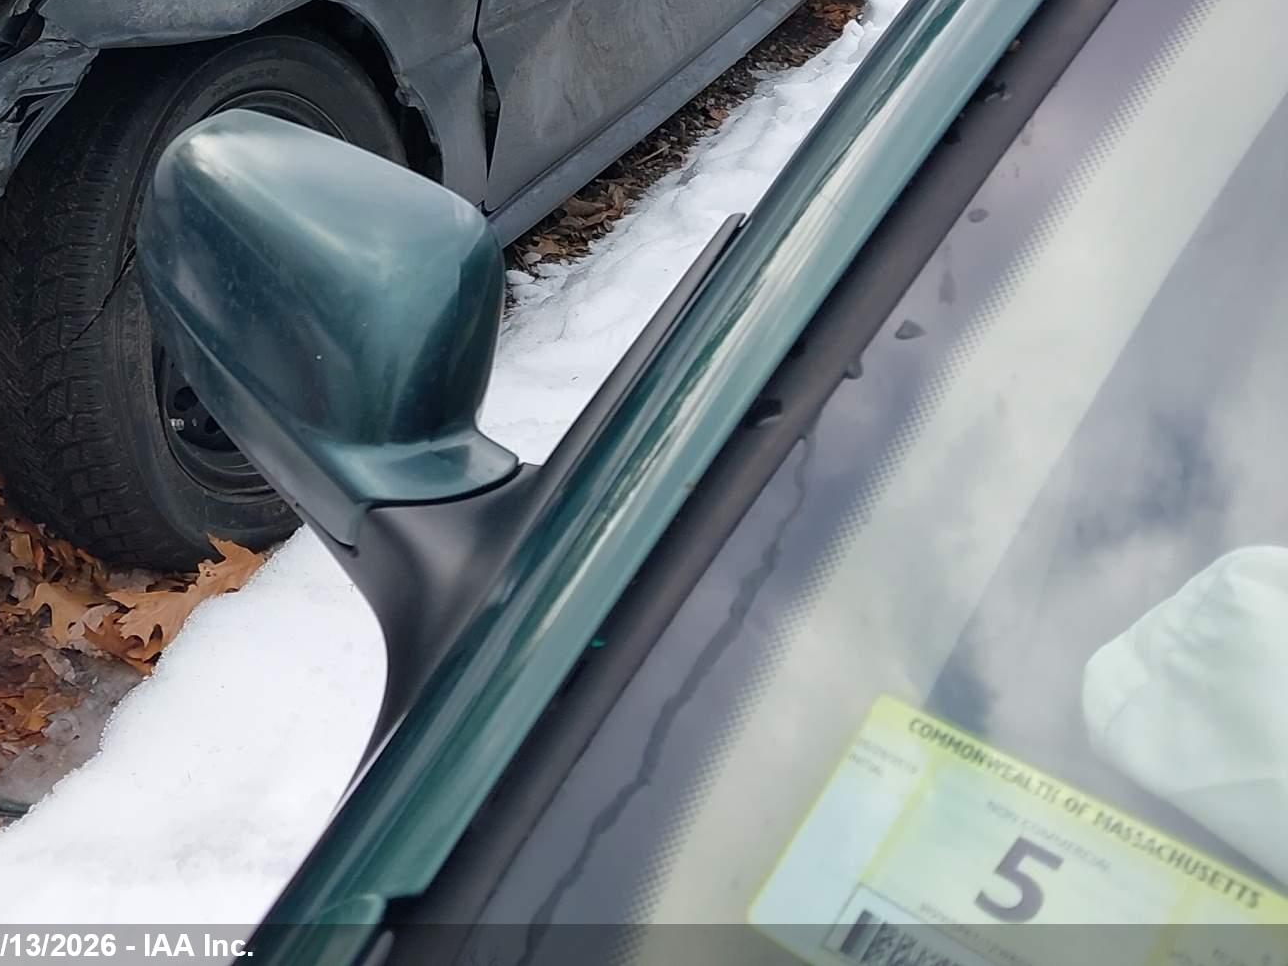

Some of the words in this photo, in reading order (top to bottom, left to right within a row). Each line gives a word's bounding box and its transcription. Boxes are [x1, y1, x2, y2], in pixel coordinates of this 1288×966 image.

[908, 718, 1059, 805] COMMONWEALTH
[1064, 797, 1091, 817] OF
[1093, 810, 1262, 909] MASSACHUSETTS
[975, 836, 1064, 923] 5
